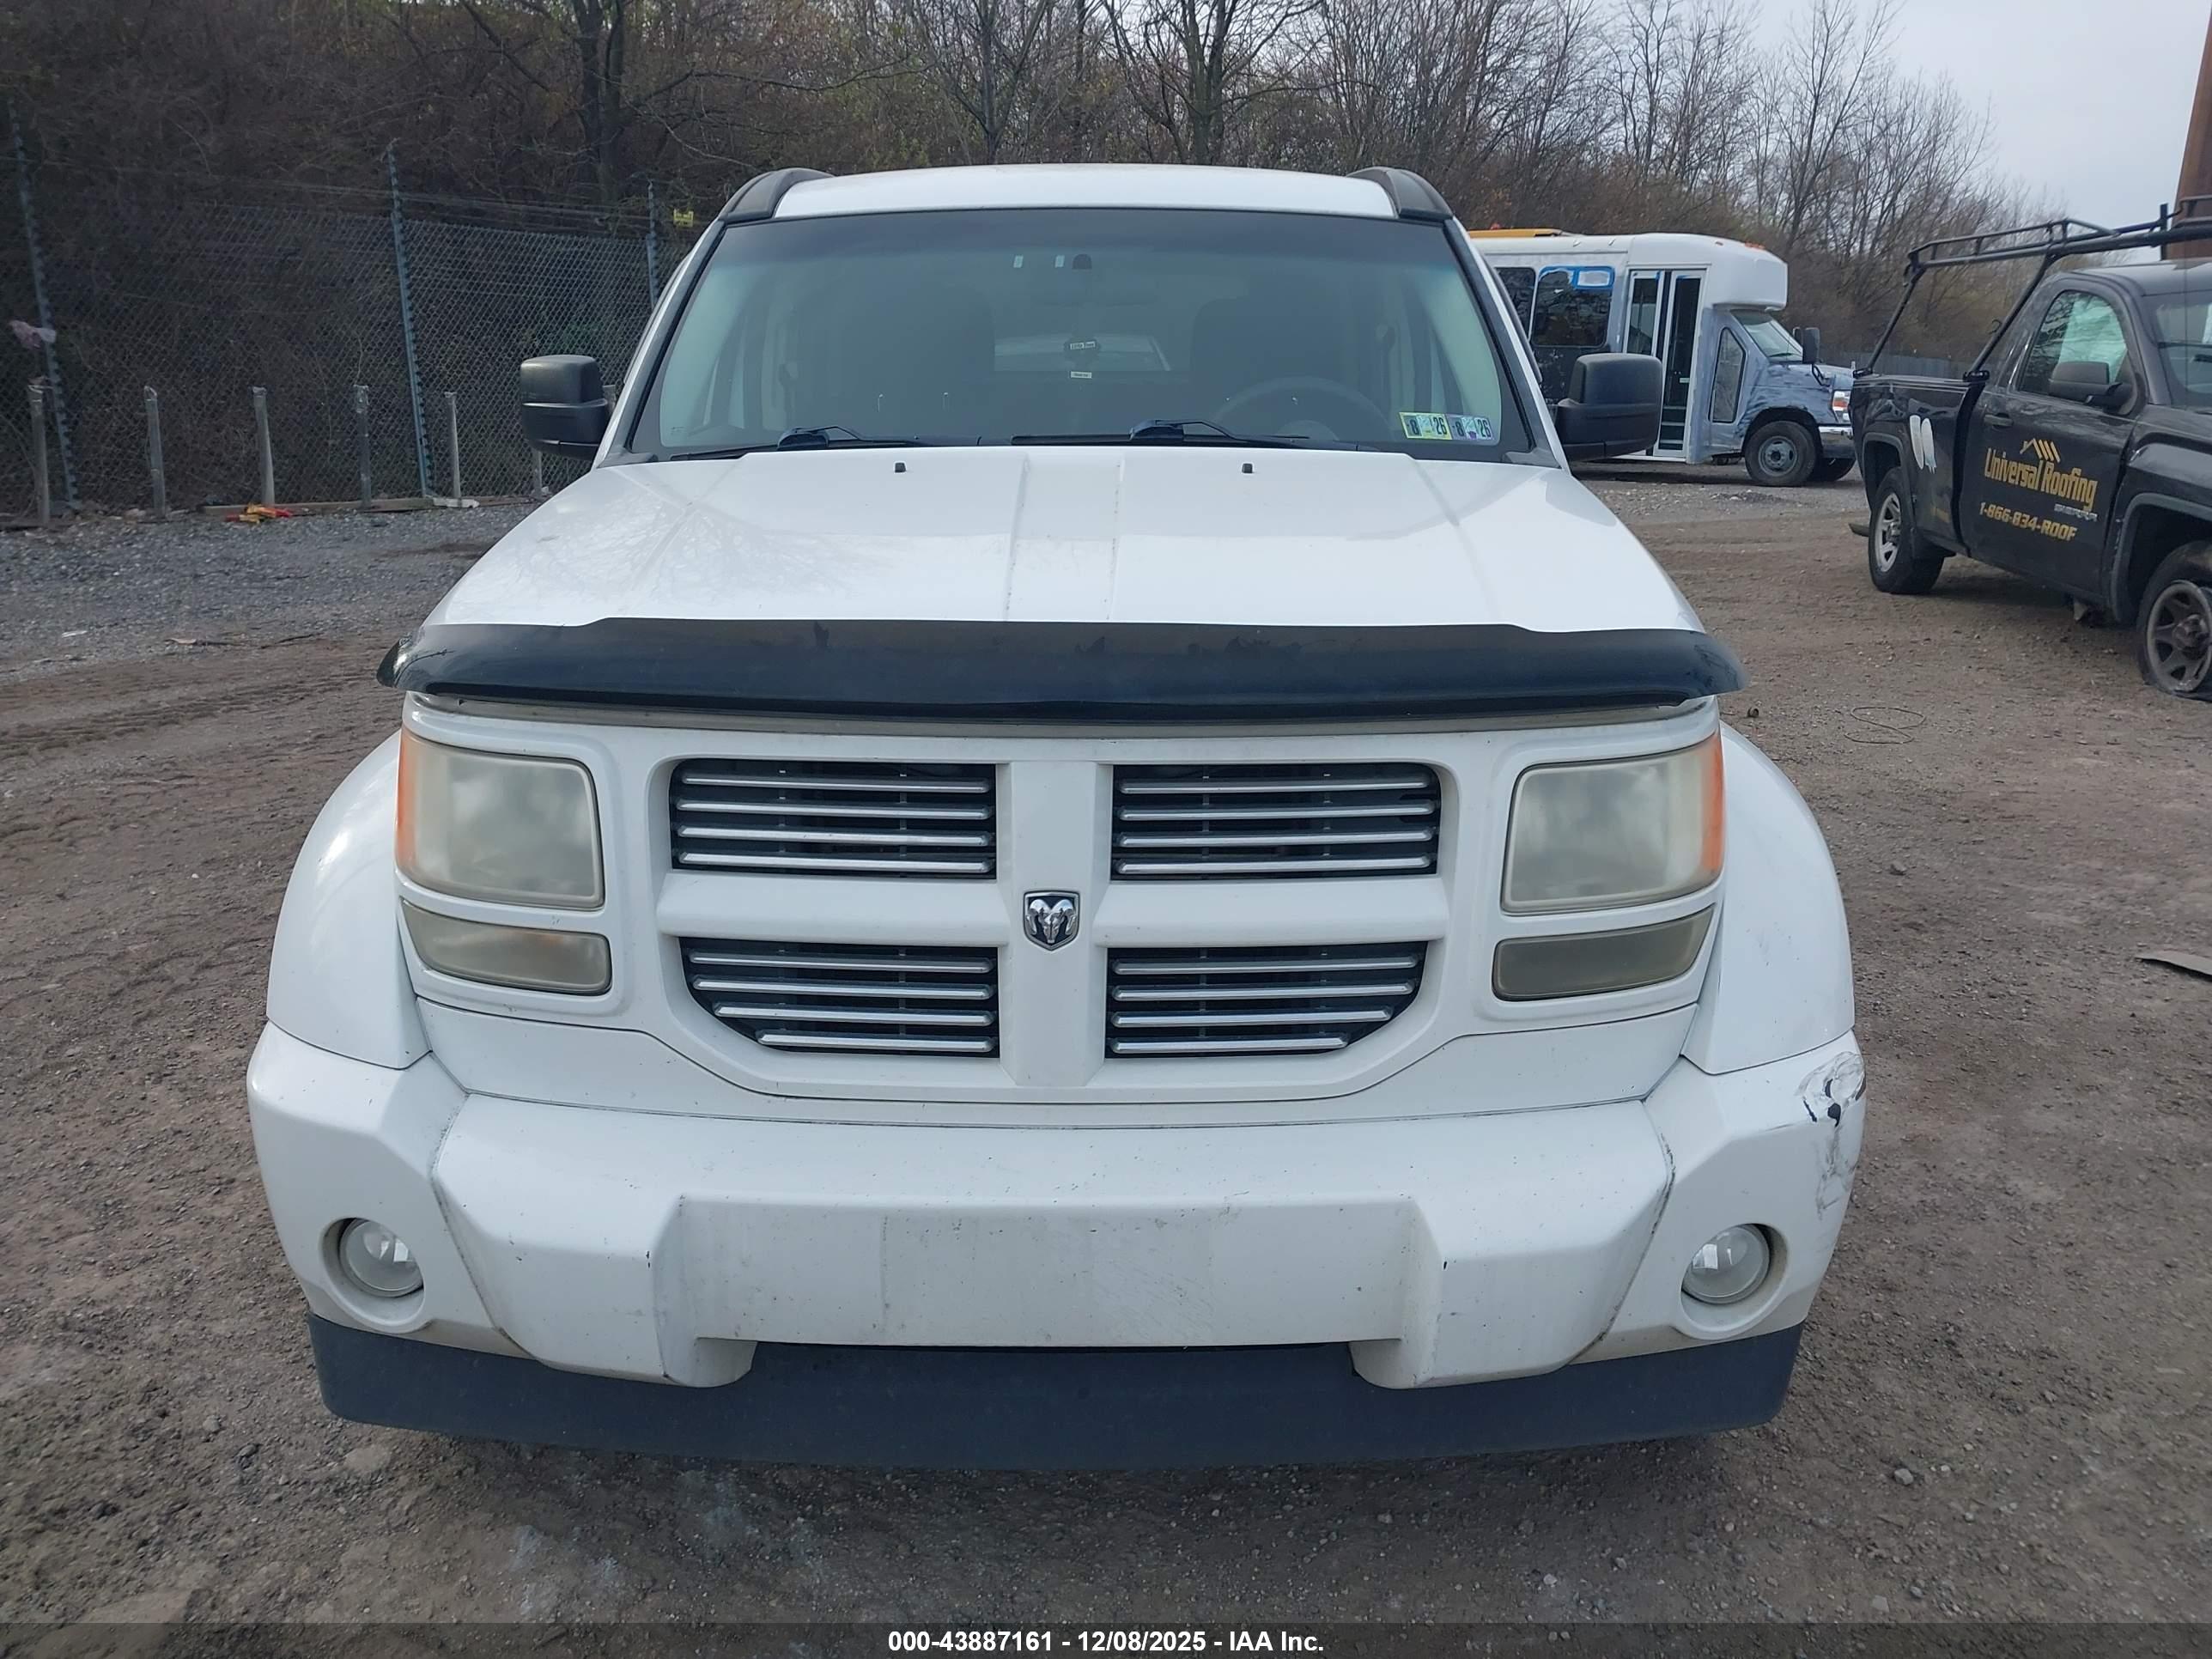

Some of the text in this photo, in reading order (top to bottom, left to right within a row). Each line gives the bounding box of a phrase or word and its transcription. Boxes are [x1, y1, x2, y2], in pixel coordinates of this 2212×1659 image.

[1433, 416, 1448, 434] 26
[1477, 419, 1492, 438] 26
[1984, 447, 2099, 513] Universal Roofing
[1979, 501, 2078, 542] 1-866-834-ROOF
